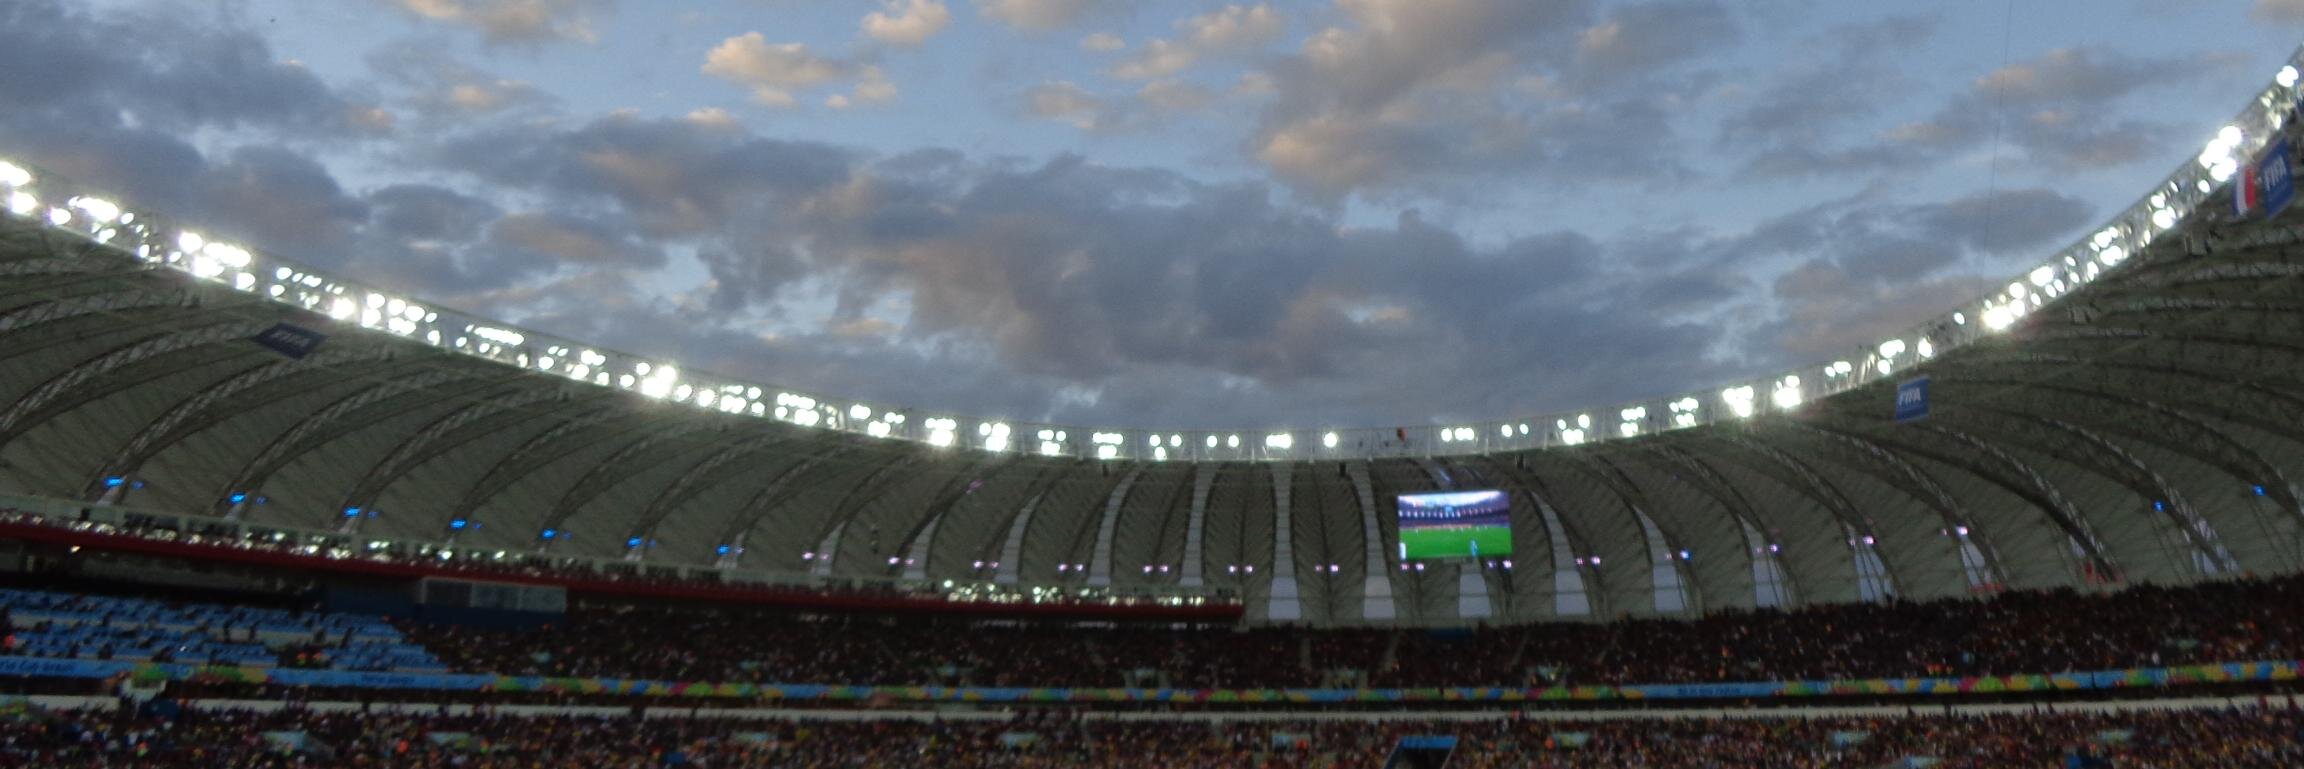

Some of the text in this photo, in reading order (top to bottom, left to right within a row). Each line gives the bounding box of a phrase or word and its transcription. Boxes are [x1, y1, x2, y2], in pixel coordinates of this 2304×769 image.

[2264, 156, 2288, 192] FIFA
[271, 330, 312, 348] FIFA
[1898, 388, 1921, 406] FIFA
